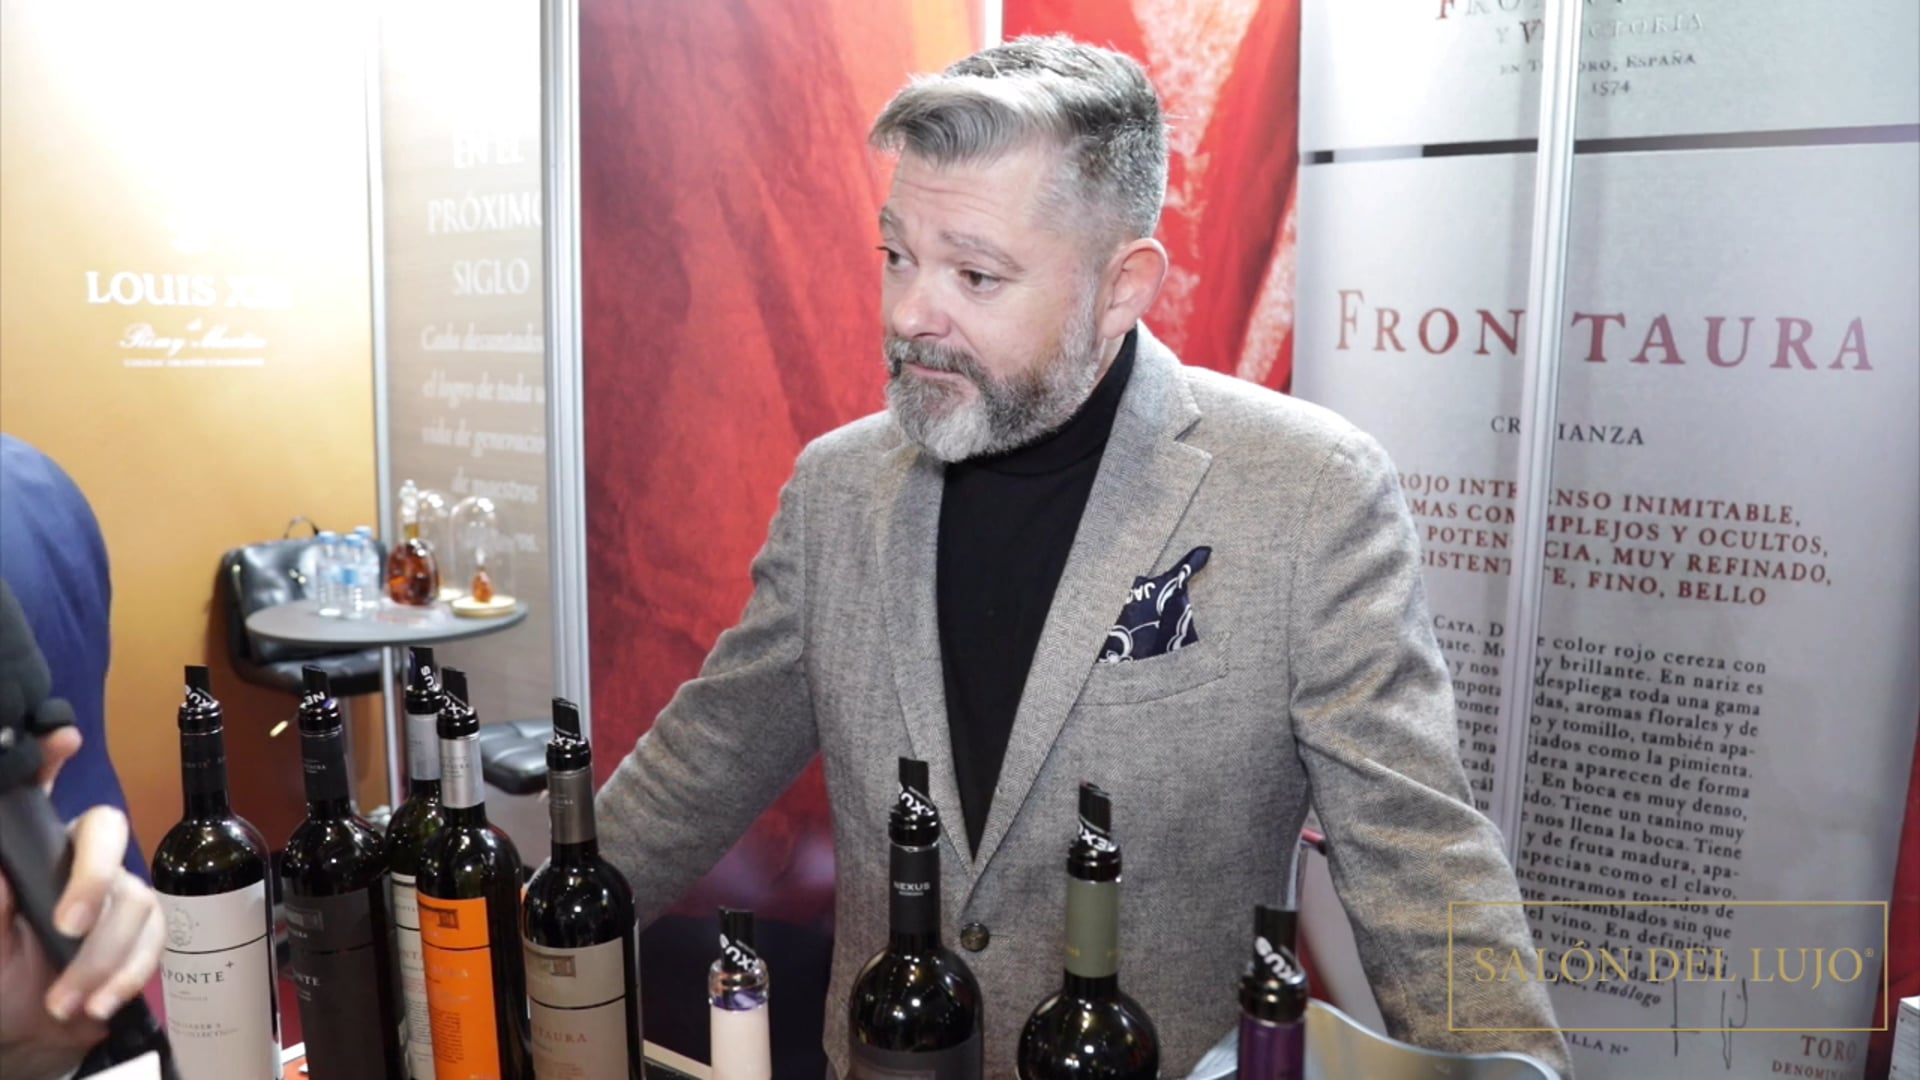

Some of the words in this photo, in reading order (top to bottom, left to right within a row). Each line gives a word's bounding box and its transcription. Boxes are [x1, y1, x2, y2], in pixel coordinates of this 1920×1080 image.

[1591, 80, 1631, 97] 1574
[85, 270, 217, 307] LOUIS
[452, 257, 530, 296] SIGLO
[1622, 493, 1801, 528] INIMITABLE,
[1671, 525, 1688, 544] Y
[1698, 527, 1829, 558] OCULTOS,
[1612, 547, 1676, 570] MUY
[1686, 553, 1832, 587] REFINADO,
[1587, 570, 1665, 599] FINO,
[1677, 580, 1767, 606] BELLO
[1553, 636, 1606, 654] color
[1614, 642, 1656, 664] rojo
[1663, 651, 1726, 670] cereza
[1733, 660, 1767, 674] con
[1470, 662, 1500, 677] nos
[1535, 671, 1622, 701] despliega
[1629, 687, 1670, 705] toda
[1677, 695, 1709, 710] una
[1715, 701, 1761, 717] gama
[1560, 655, 1651, 683] brillante.
[1660, 668, 1686, 686] En
[1693, 676, 1740, 693] nariz
[1746, 683, 1764, 695] es
[1576, 701, 1642, 721] aromas
[1648, 708, 1719, 731] florales
[1725, 724, 1734, 739] y
[1739, 721, 1759, 737] de
[1548, 718, 1558, 732] y
[1563, 718, 1636, 743] tomillo,
[1641, 730, 1714, 752] también
[1719, 743, 1756, 760] apa-
[1588, 744, 1640, 762] como
[1647, 749, 1663, 765] la
[1669, 755, 1752, 778] pimienta.
[1542, 772, 1565, 789] En
[1572, 776, 1616, 798] boca
[1623, 787, 1641, 801] es
[1647, 793, 1687, 812] muy
[1692, 796, 1748, 822] denso,
[1575, 761, 1663, 786] aparecen
[1670, 774, 1691, 791] de
[1697, 777, 1750, 799] forma
[1534, 813, 1565, 829] nos
[1570, 814, 1614, 838] llena
[1620, 825, 1636, 843] la
[1642, 828, 1690, 851] boca.
[1693, 837, 1742, 861] Tiene
[1560, 793, 1613, 818] Tiene
[1619, 808, 1641, 823] un
[1647, 811, 1704, 833] tanino
[1709, 822, 1745, 845] muy
[1526, 831, 1537, 846] y
[1542, 831, 1563, 847] de
[1569, 836, 1615, 858] fruta
[1621, 850, 1696, 875] madura,
[1702, 862, 1740, 881] apa-
[1599, 865, 1653, 885] como
[1660, 872, 1677, 890] el
[1684, 876, 1737, 900] clavo.
[1551, 912, 1598, 933] vino.
[1605, 921, 1629, 938] En
[1672, 917, 1698, 933] sin
[1703, 925, 1732, 940] que
[1714, 903, 1735, 920] de
[1594, 980, 1662, 1008] Enólogo
[1801, 1035, 1857, 1062] TORO
